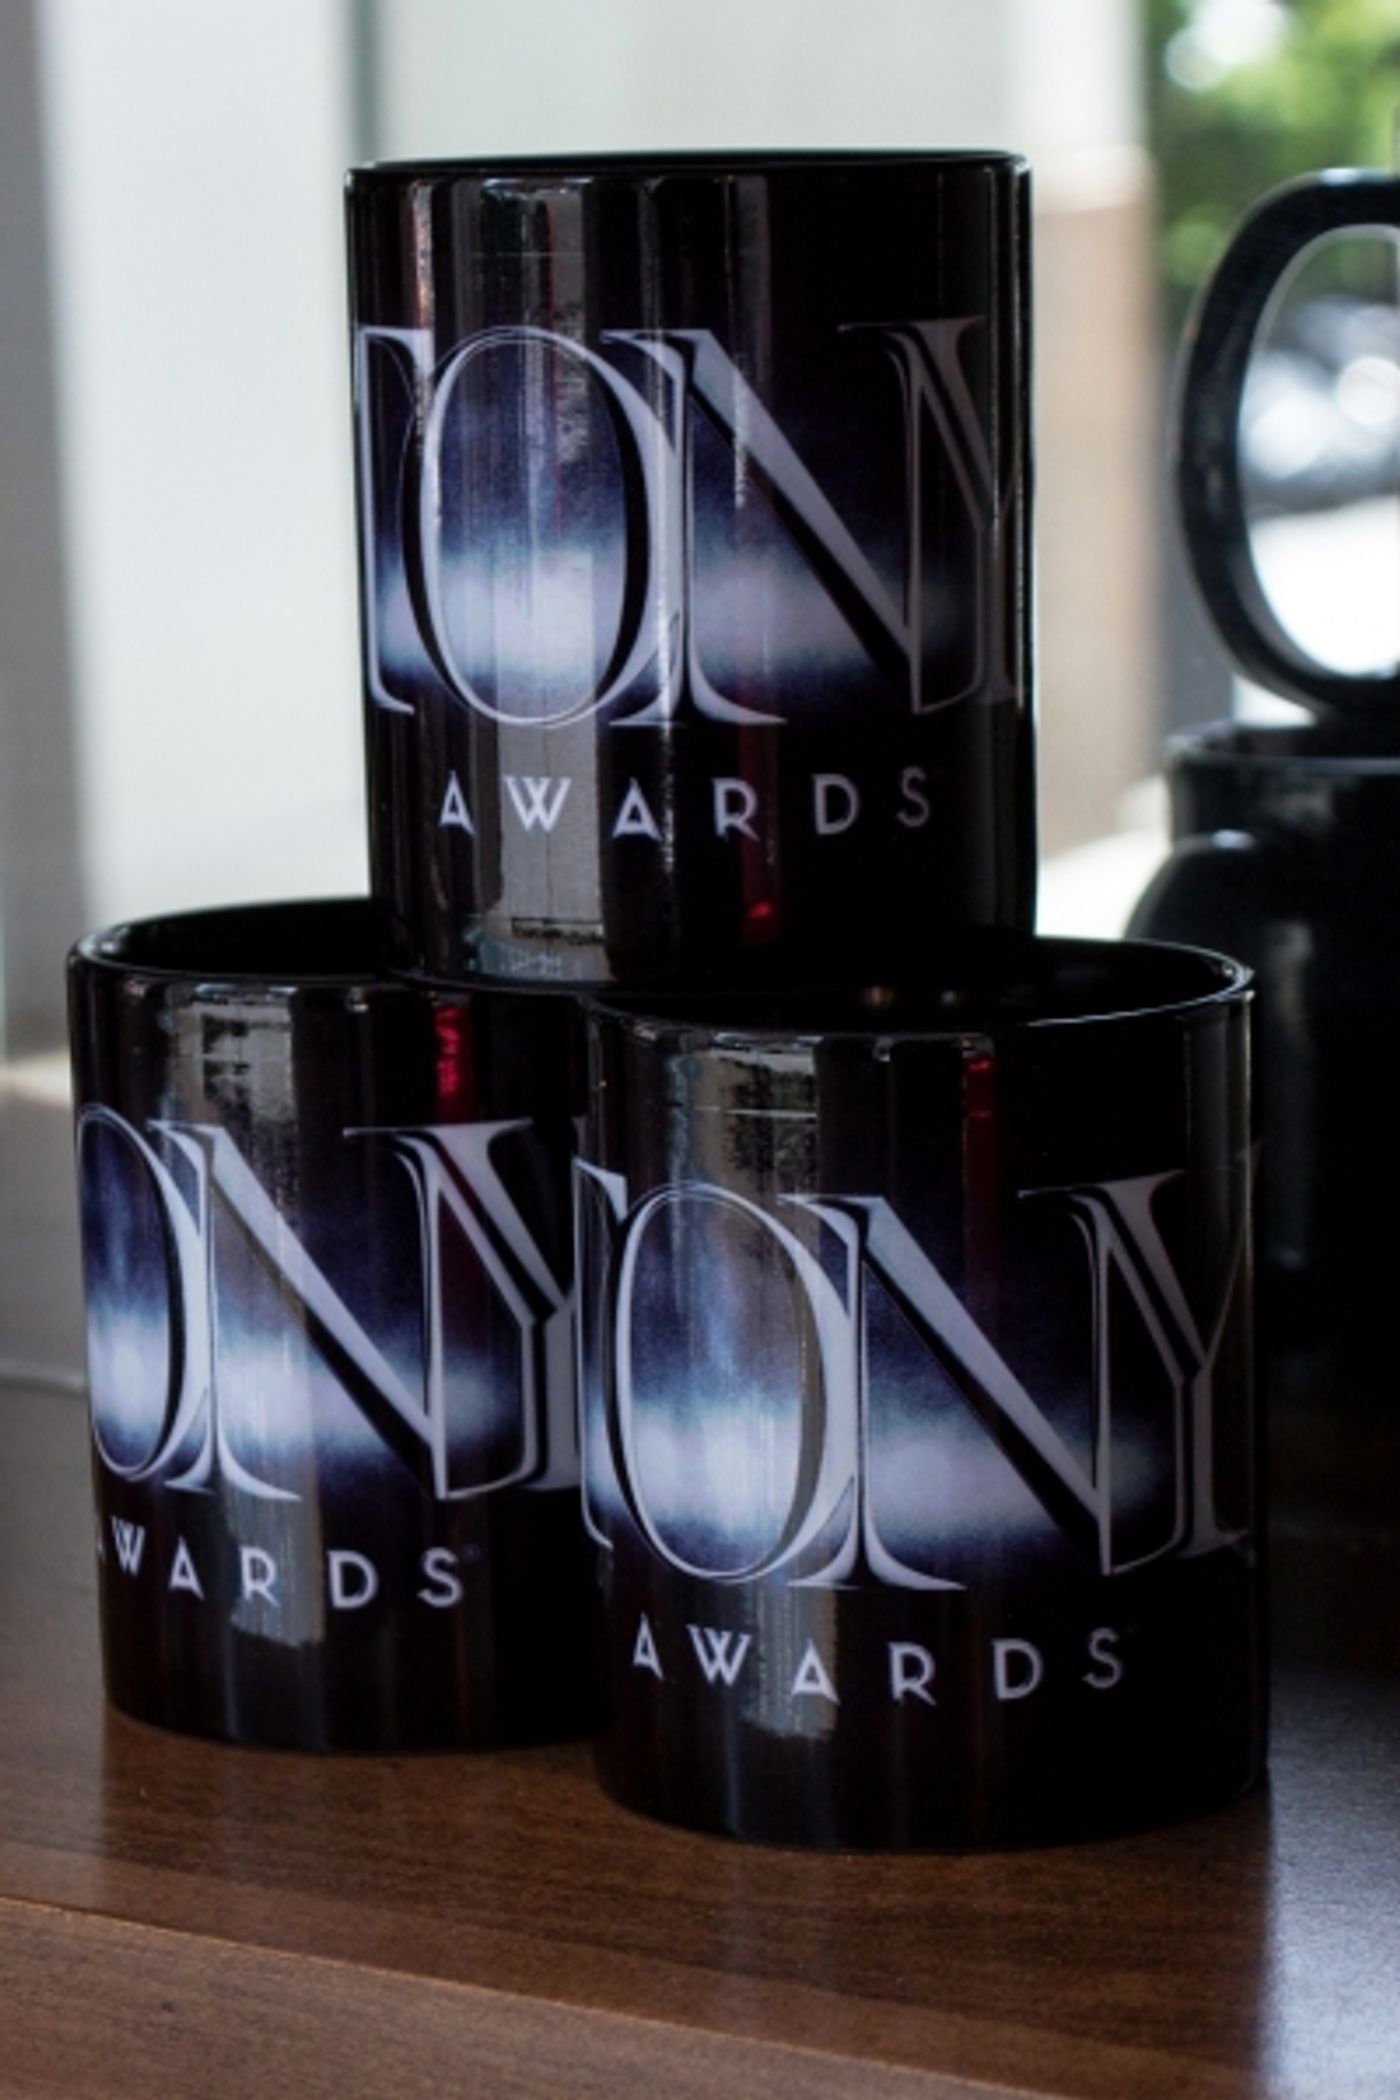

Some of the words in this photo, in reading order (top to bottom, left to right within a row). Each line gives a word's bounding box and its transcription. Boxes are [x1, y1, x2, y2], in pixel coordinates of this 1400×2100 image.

[438, 765, 931, 841] AWARDS
[97, 1516, 463, 1609] WARDS
[632, 1612, 1122, 1705] AWARDS
